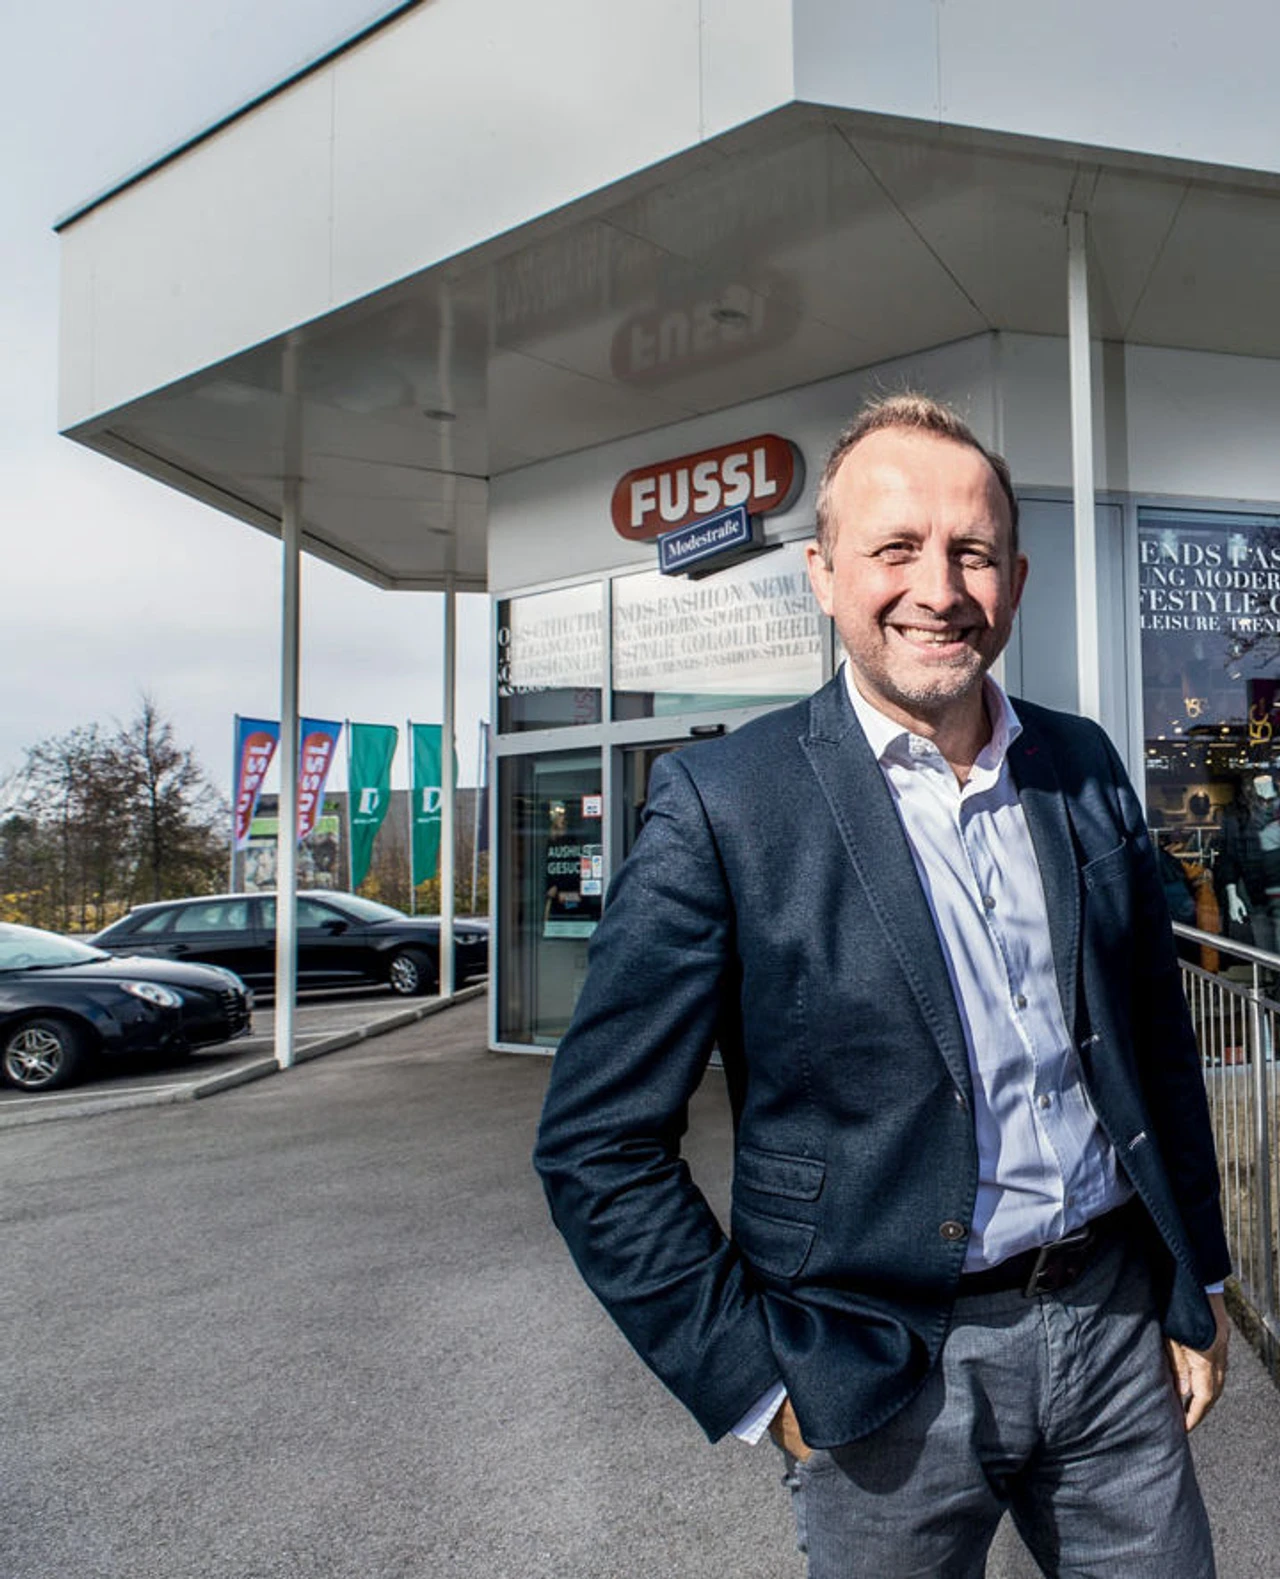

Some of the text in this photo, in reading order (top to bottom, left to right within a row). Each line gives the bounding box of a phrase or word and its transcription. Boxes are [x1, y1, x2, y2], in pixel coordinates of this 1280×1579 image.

[631, 447, 777, 528] FUSSL
[668, 518, 740, 558] Modestraße
[1141, 540, 1222, 567] ENDS
[1141, 615, 1221, 631] LEISURE
[299, 741, 331, 831] FUSSL
